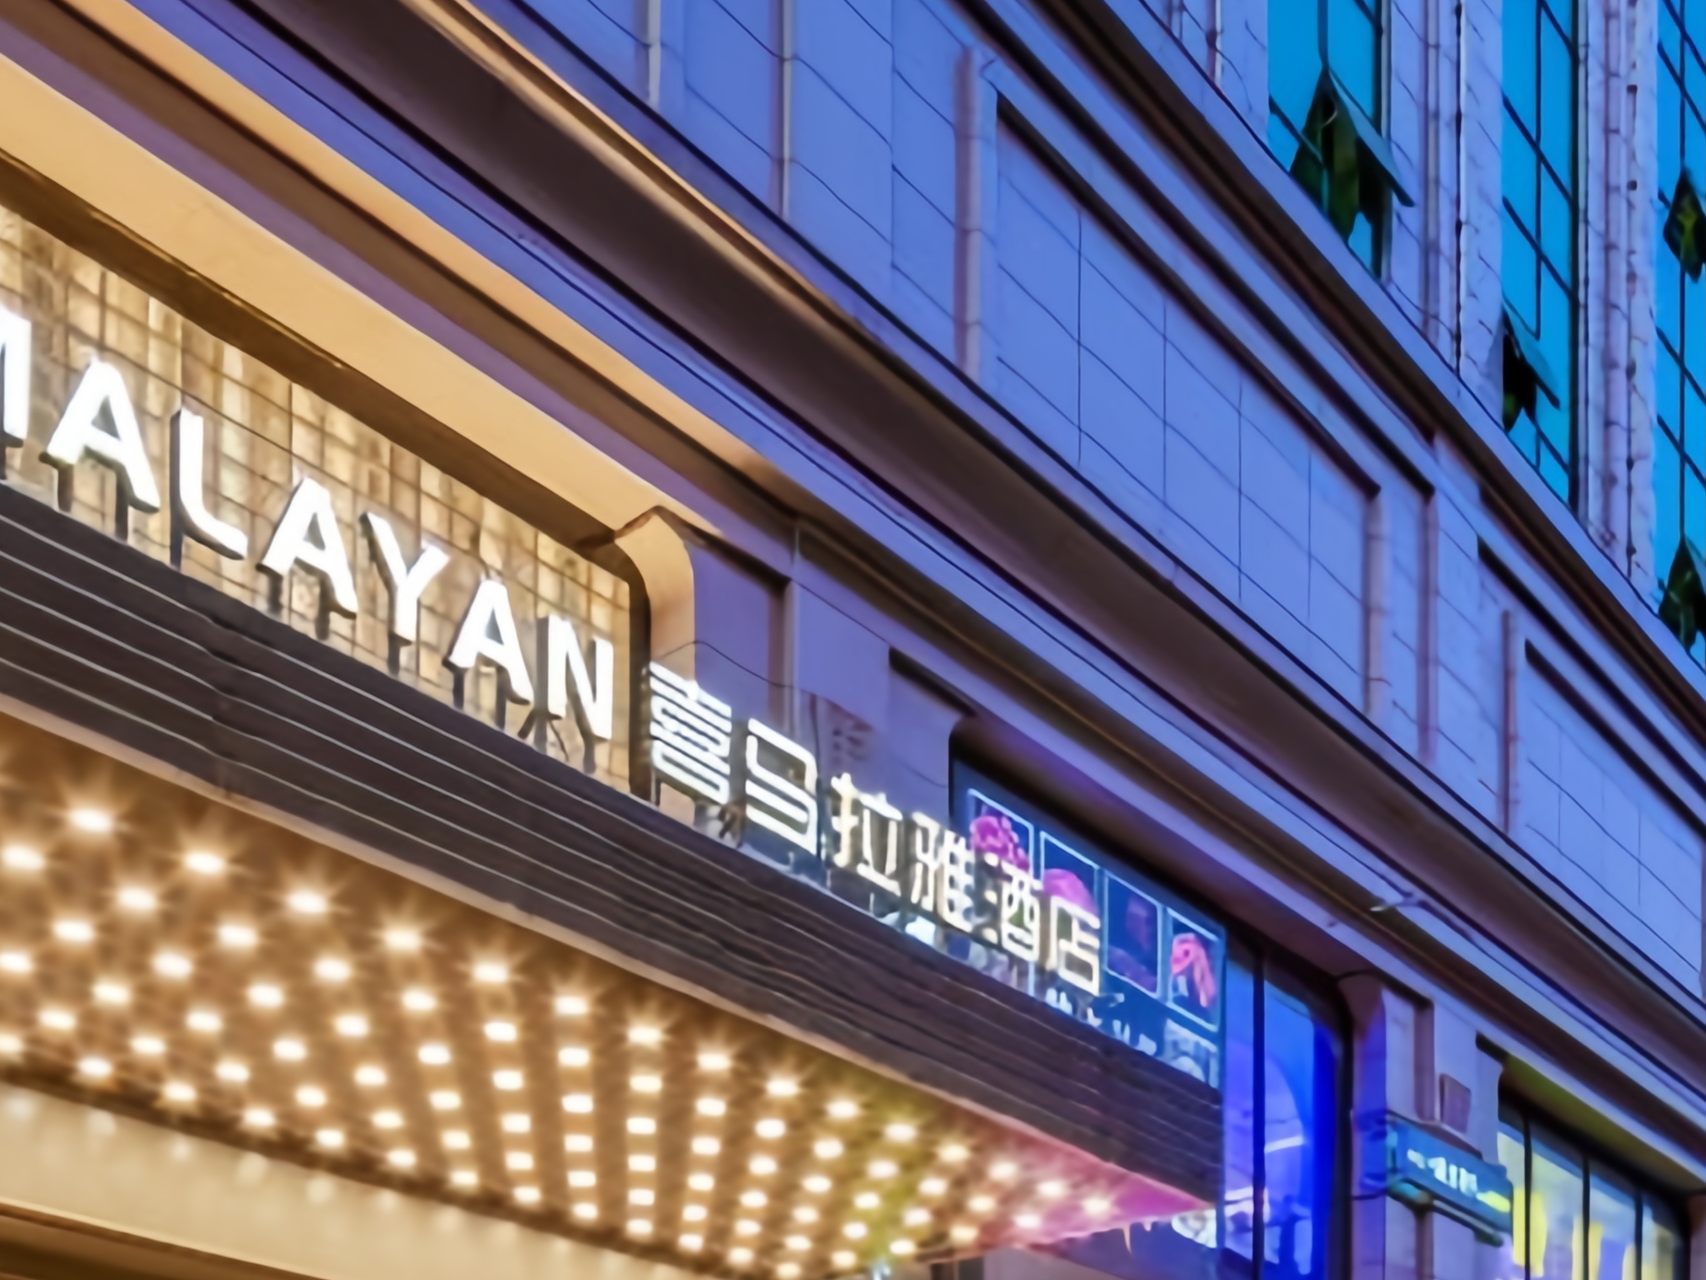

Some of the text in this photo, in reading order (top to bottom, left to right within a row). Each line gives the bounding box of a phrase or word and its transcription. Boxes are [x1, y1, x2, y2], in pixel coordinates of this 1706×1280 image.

[649, 660, 1101, 998] 喜马拉雅酒店
